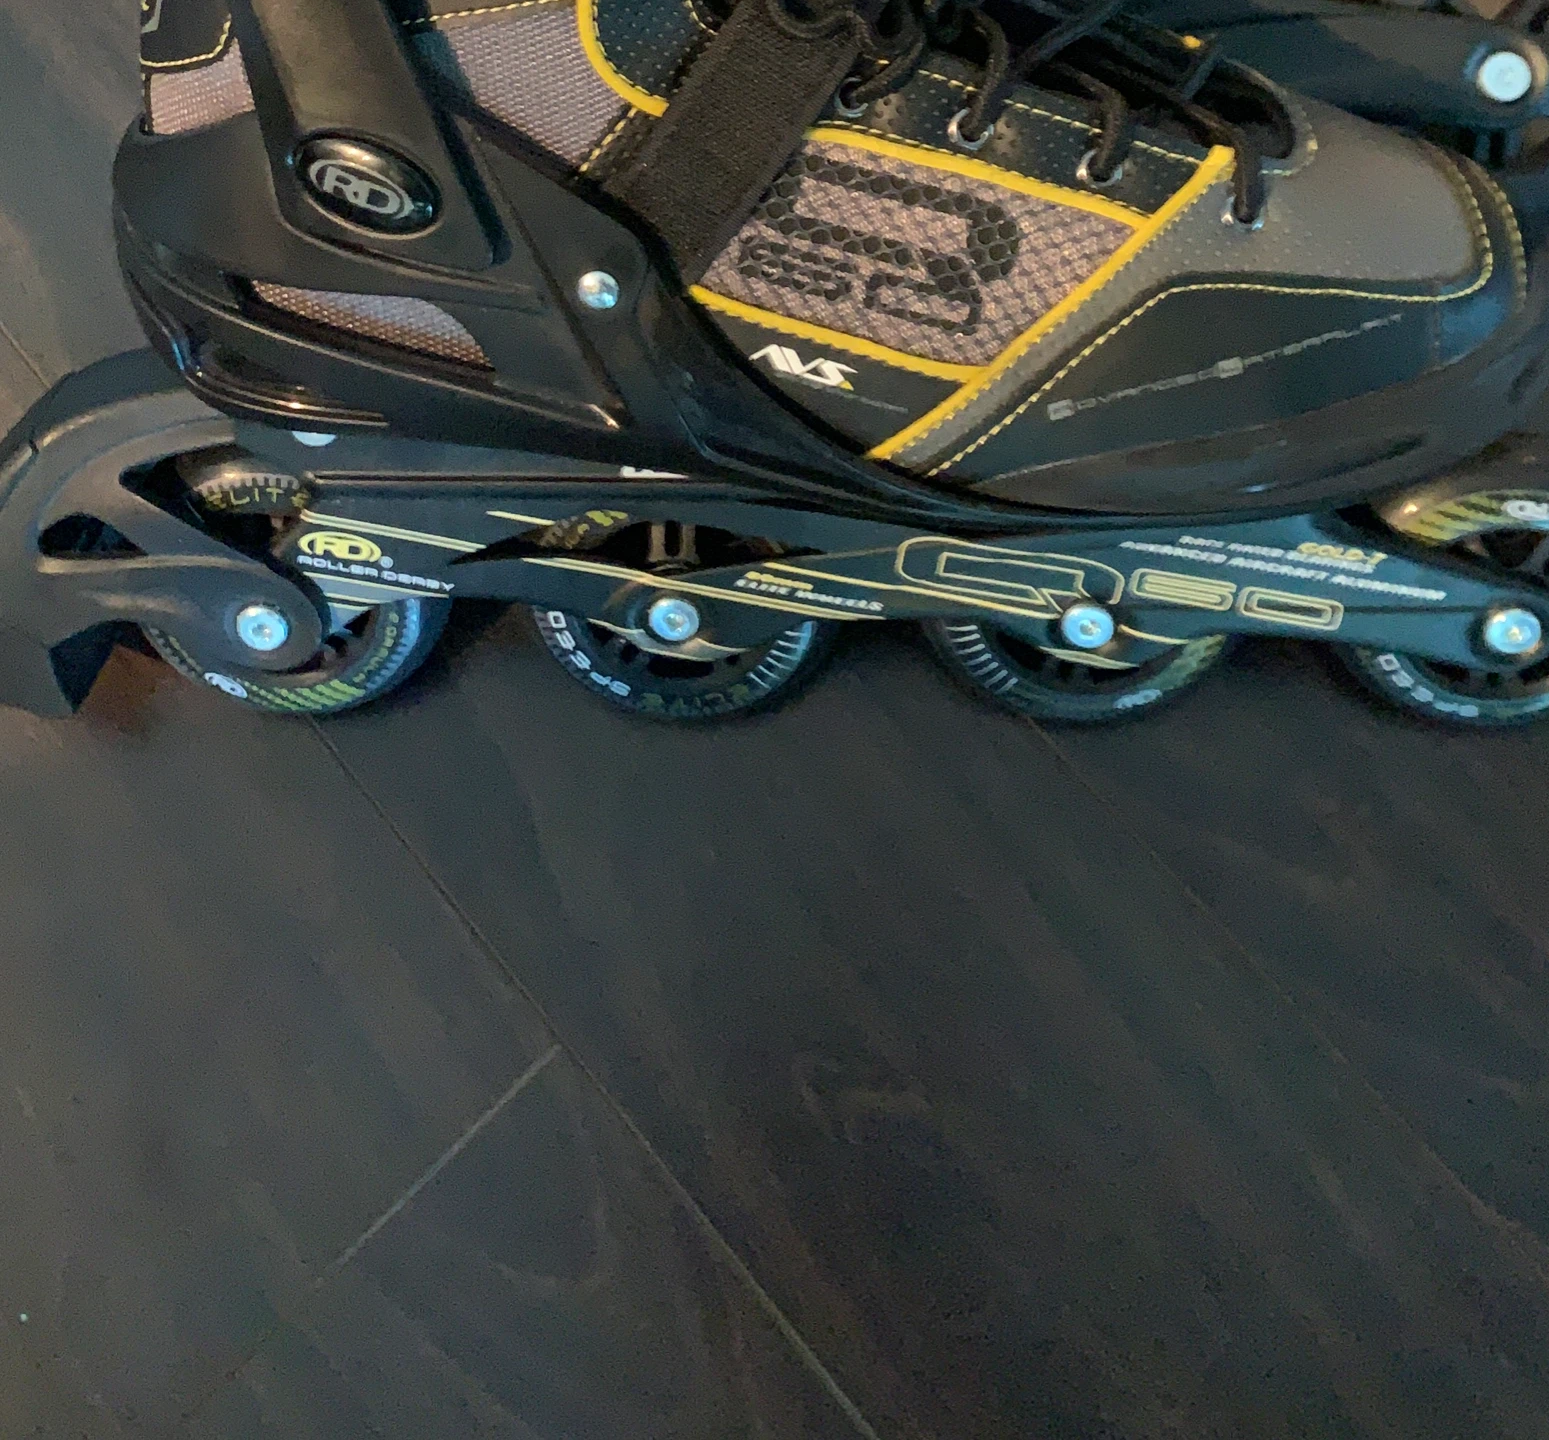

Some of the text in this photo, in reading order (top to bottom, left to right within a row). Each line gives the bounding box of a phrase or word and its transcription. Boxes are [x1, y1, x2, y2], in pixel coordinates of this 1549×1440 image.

[322, 165, 402, 215] RD
[297, 555, 455, 592] ROLLER DERBY
[546, 610, 632, 697] SPEED
